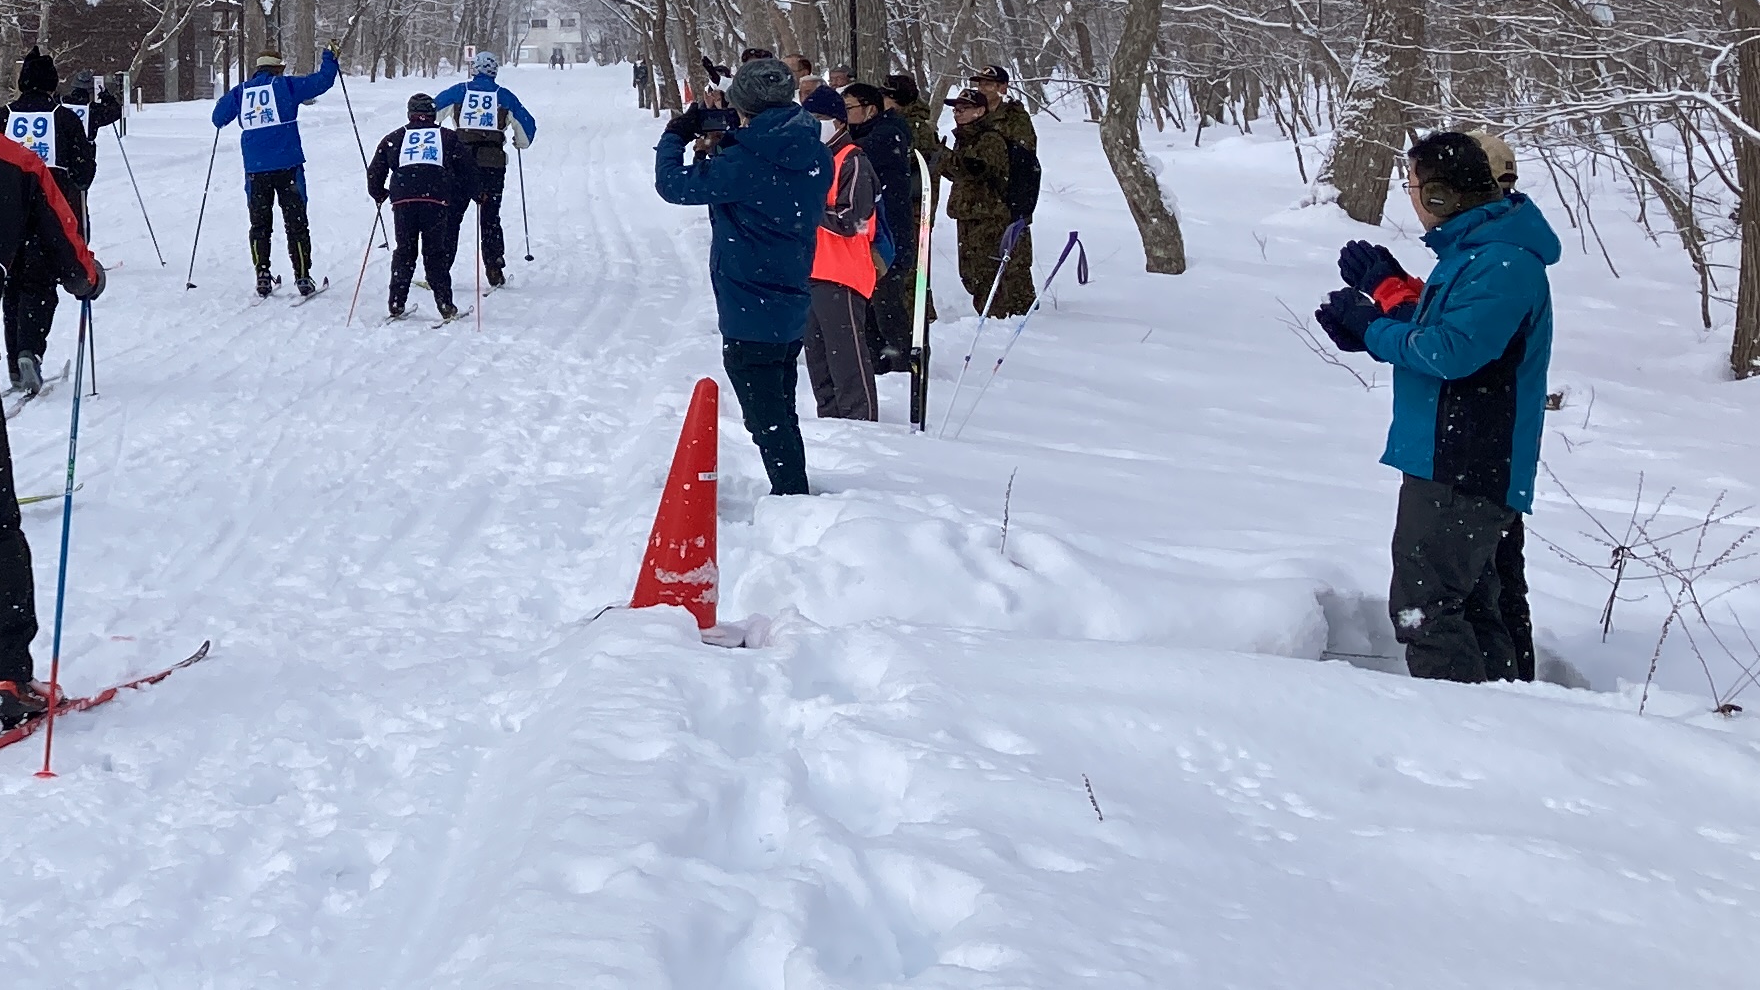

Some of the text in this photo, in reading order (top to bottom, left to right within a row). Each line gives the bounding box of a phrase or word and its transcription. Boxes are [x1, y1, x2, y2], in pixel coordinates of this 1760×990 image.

[246, 90, 270, 108] 70
[468, 94, 492, 109] 58
[244, 108, 275, 126] 千歳
[463, 111, 494, 127] 千歳
[13, 117, 47, 138] 69
[409, 131, 435, 145] 62
[404, 146, 438, 161] 千歳
